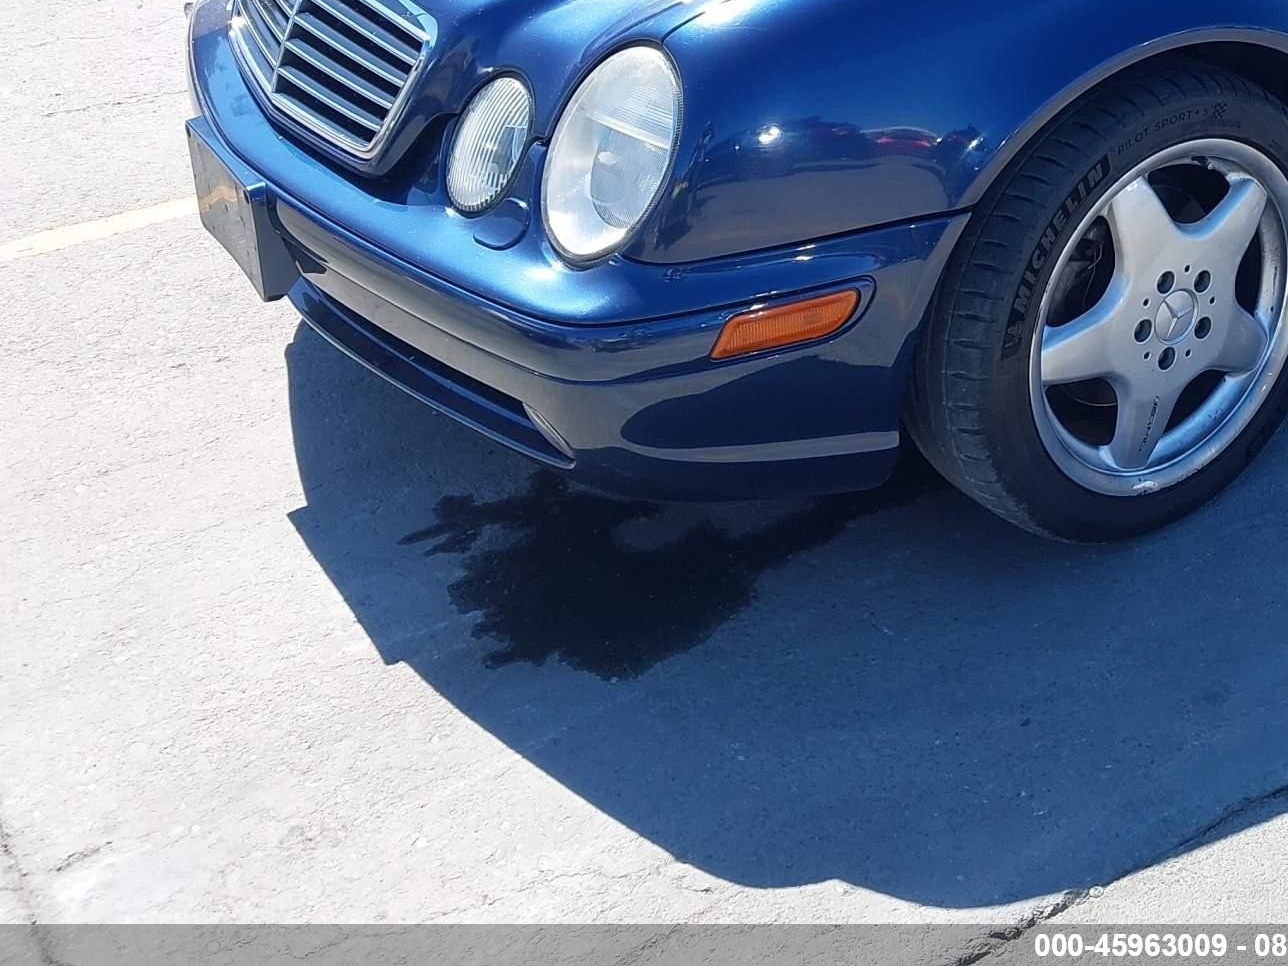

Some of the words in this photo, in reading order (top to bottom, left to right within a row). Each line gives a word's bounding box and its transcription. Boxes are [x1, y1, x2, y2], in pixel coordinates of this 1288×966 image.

[1117, 128, 1149, 154] PILOT
[1154, 110, 1193, 131] SPORT
[1013, 162, 1104, 314] MICHELIN
